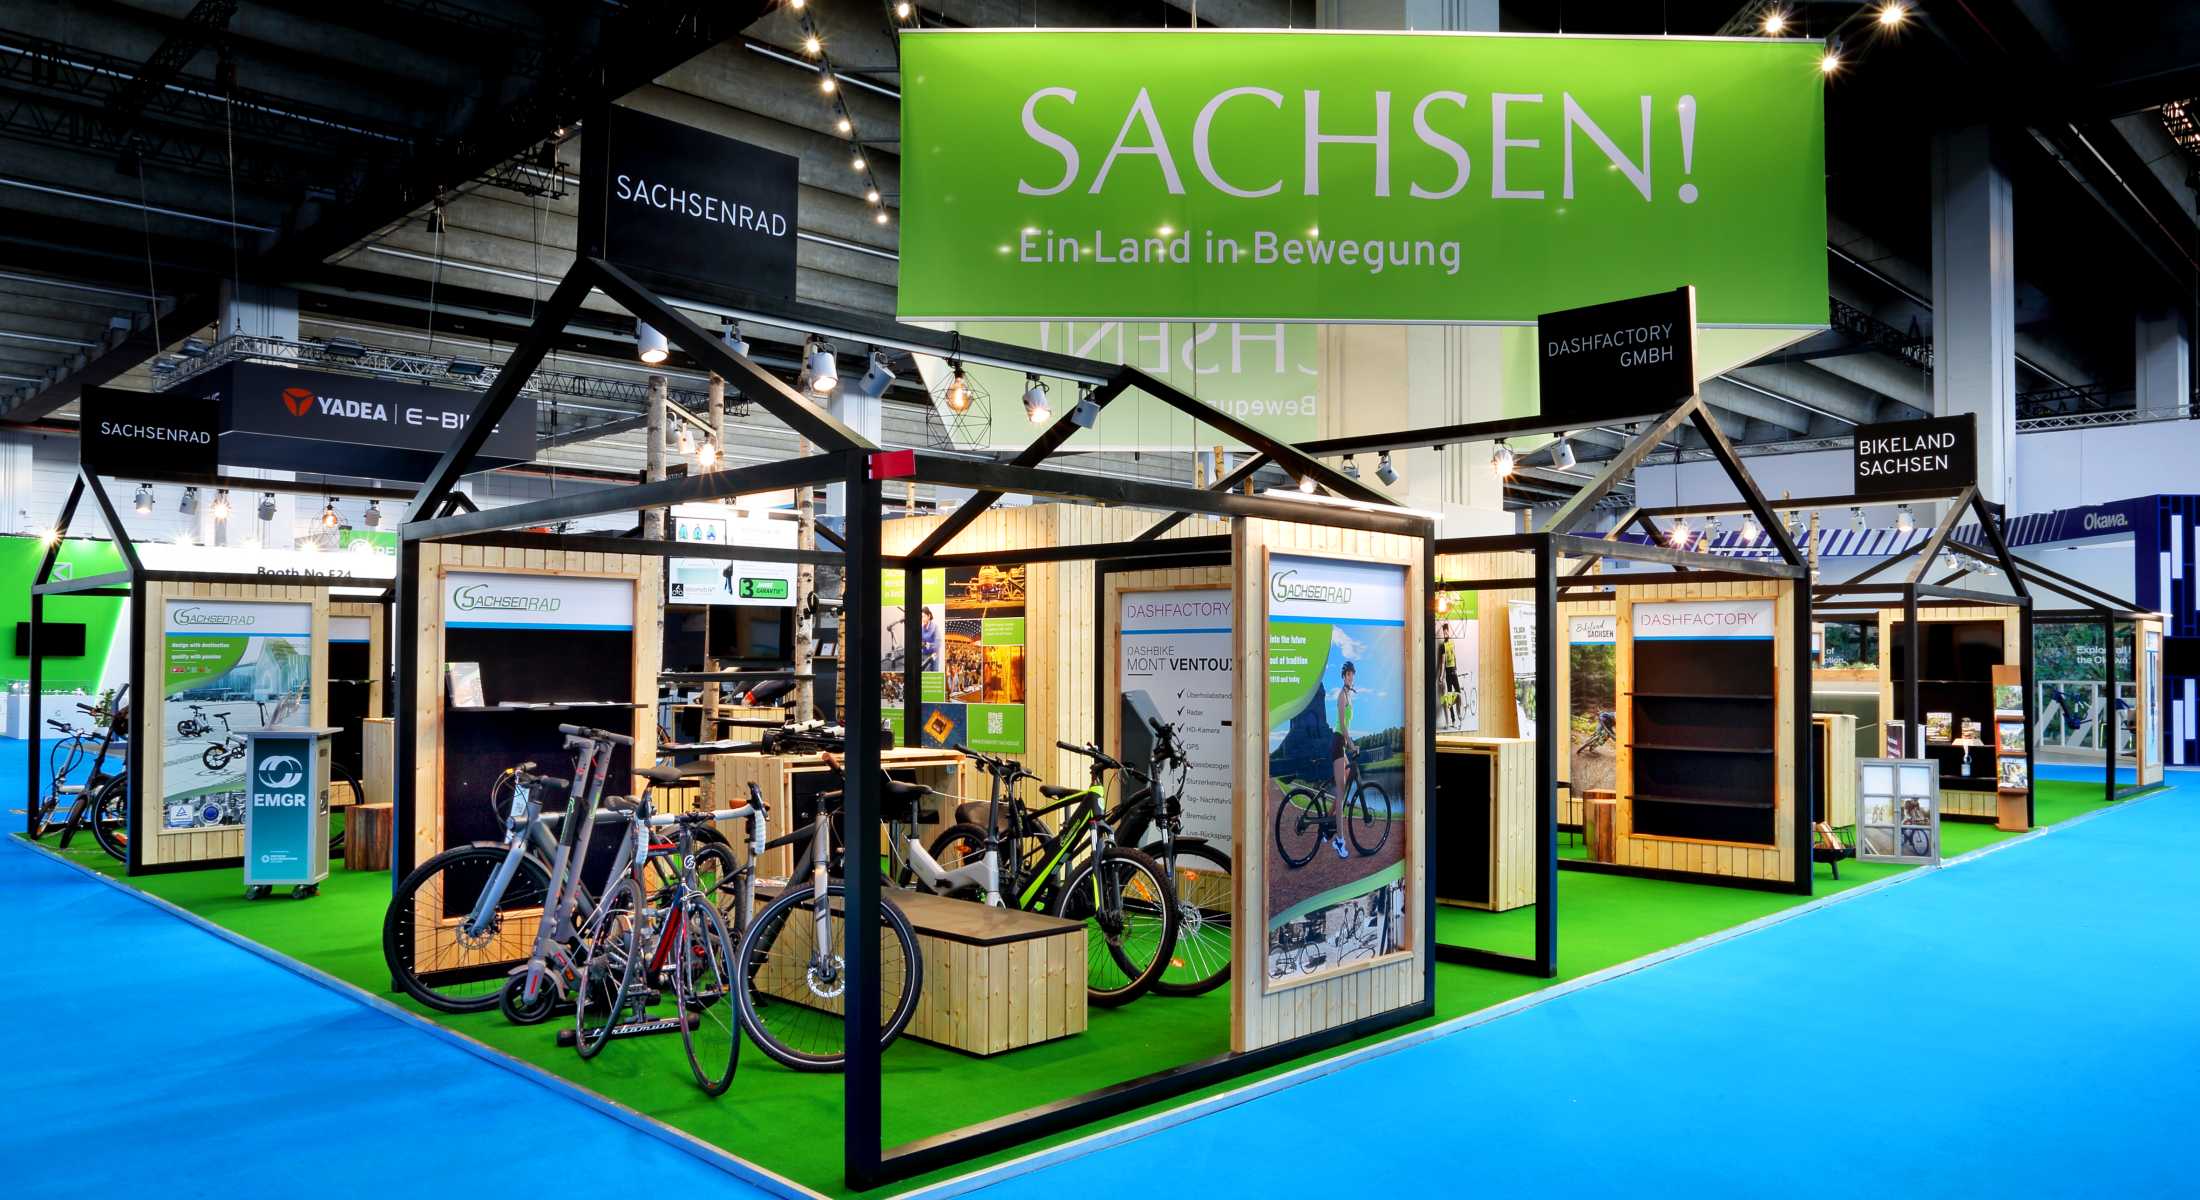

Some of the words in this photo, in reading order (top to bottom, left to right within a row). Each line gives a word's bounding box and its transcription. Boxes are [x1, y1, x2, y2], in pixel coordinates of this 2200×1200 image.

[1017, 86, 1699, 203] SACHSEN!
[616, 174, 787, 237] SACHSENRAD
[1019, 230, 1079, 263] Ein
[1096, 230, 1190, 263] Land
[1205, 231, 1239, 264] in
[1254, 231, 1461, 275] Bewegung
[1548, 323, 1673, 357] DASHFACTORY
[1620, 345, 1673, 367] GMBH
[317, 396, 388, 421] YADEA
[101, 421, 211, 444] SACHSENRAD
[1860, 432, 1955, 455] BIKELAND
[1860, 454, 1948, 476] SACHSEN
[742, 578, 753, 598] 3
[1128, 602, 1231, 619] DASHFACTORY
[1641, 612, 1758, 626] DASHFACTORY
[1128, 646, 1175, 656] DASHBIKE
[1128, 658, 1166, 671] MONT
[254, 793, 306, 807] EMGR
